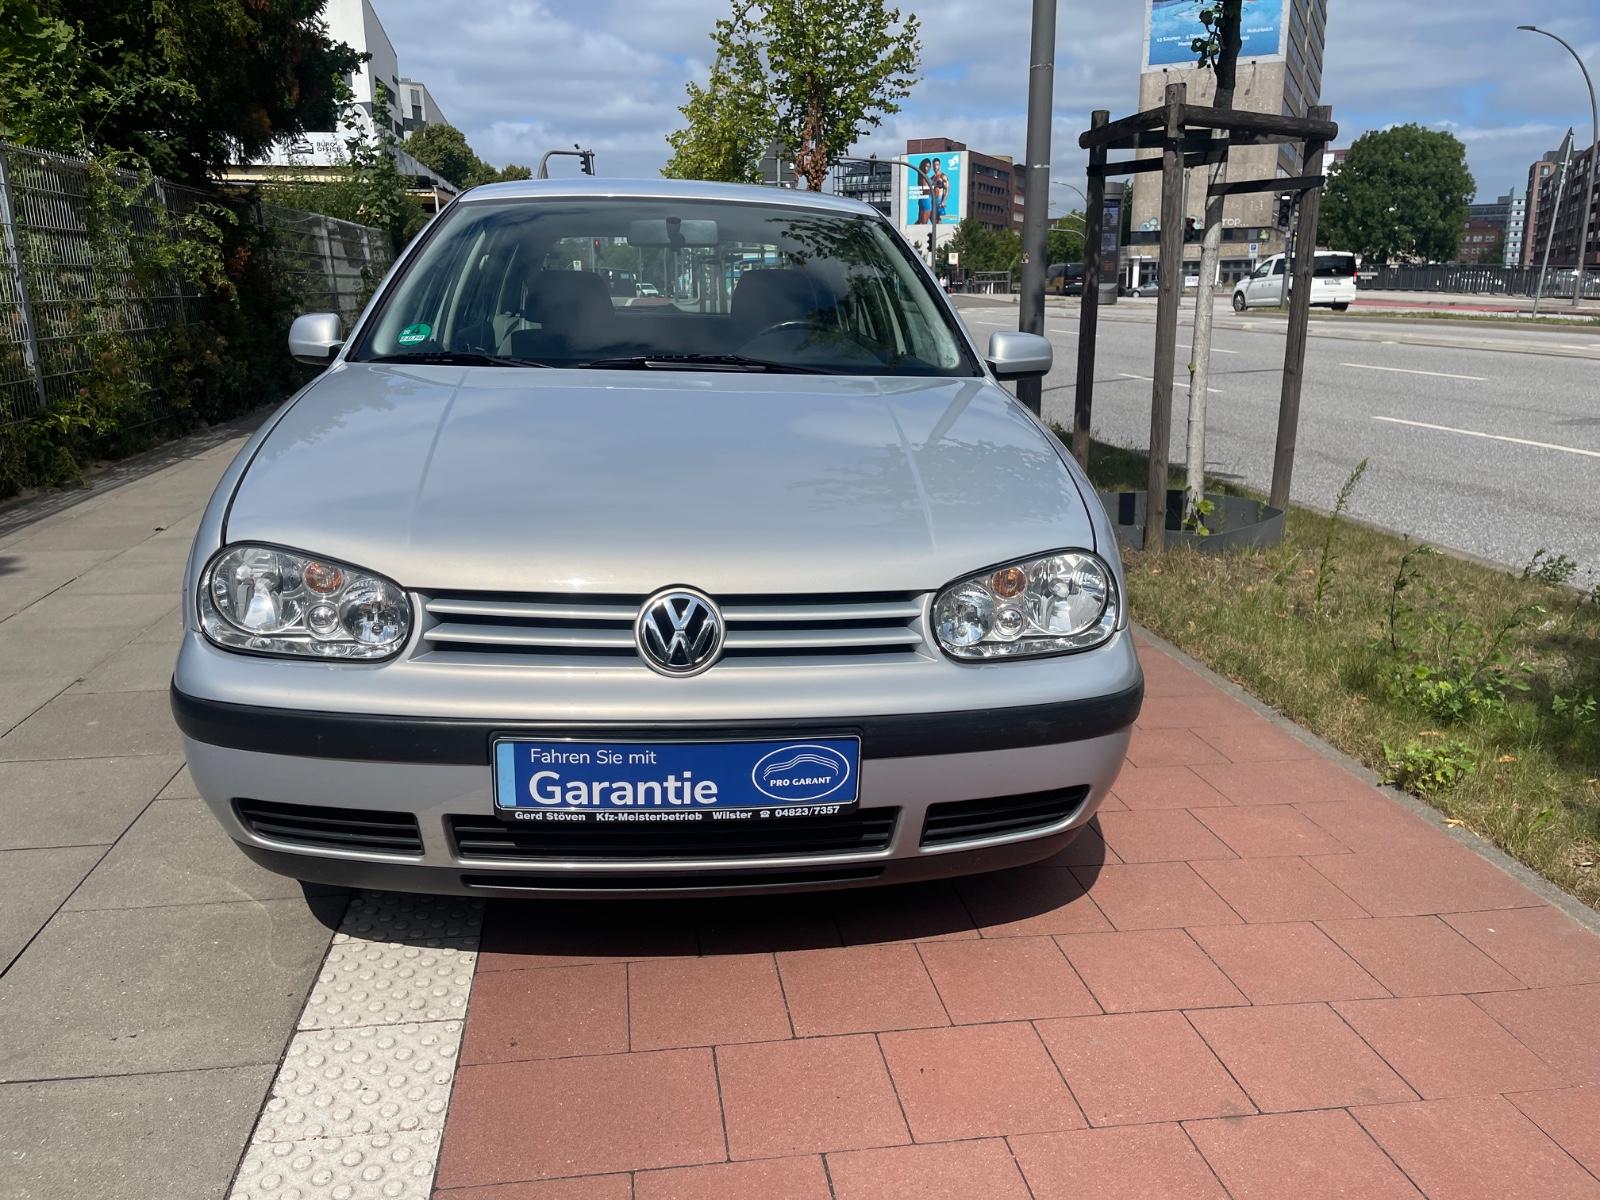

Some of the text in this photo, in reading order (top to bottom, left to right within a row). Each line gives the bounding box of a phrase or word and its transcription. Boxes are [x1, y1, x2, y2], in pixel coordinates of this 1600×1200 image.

[530, 748, 657, 765] Fahren Sie mit
[528, 770, 718, 806] Garantie
[769, 776, 832, 787] PRO GARANT
[514, 805, 840, 822] Gerd Stöven Kfz-Meisterbetrieb Wilster 04823/7357
